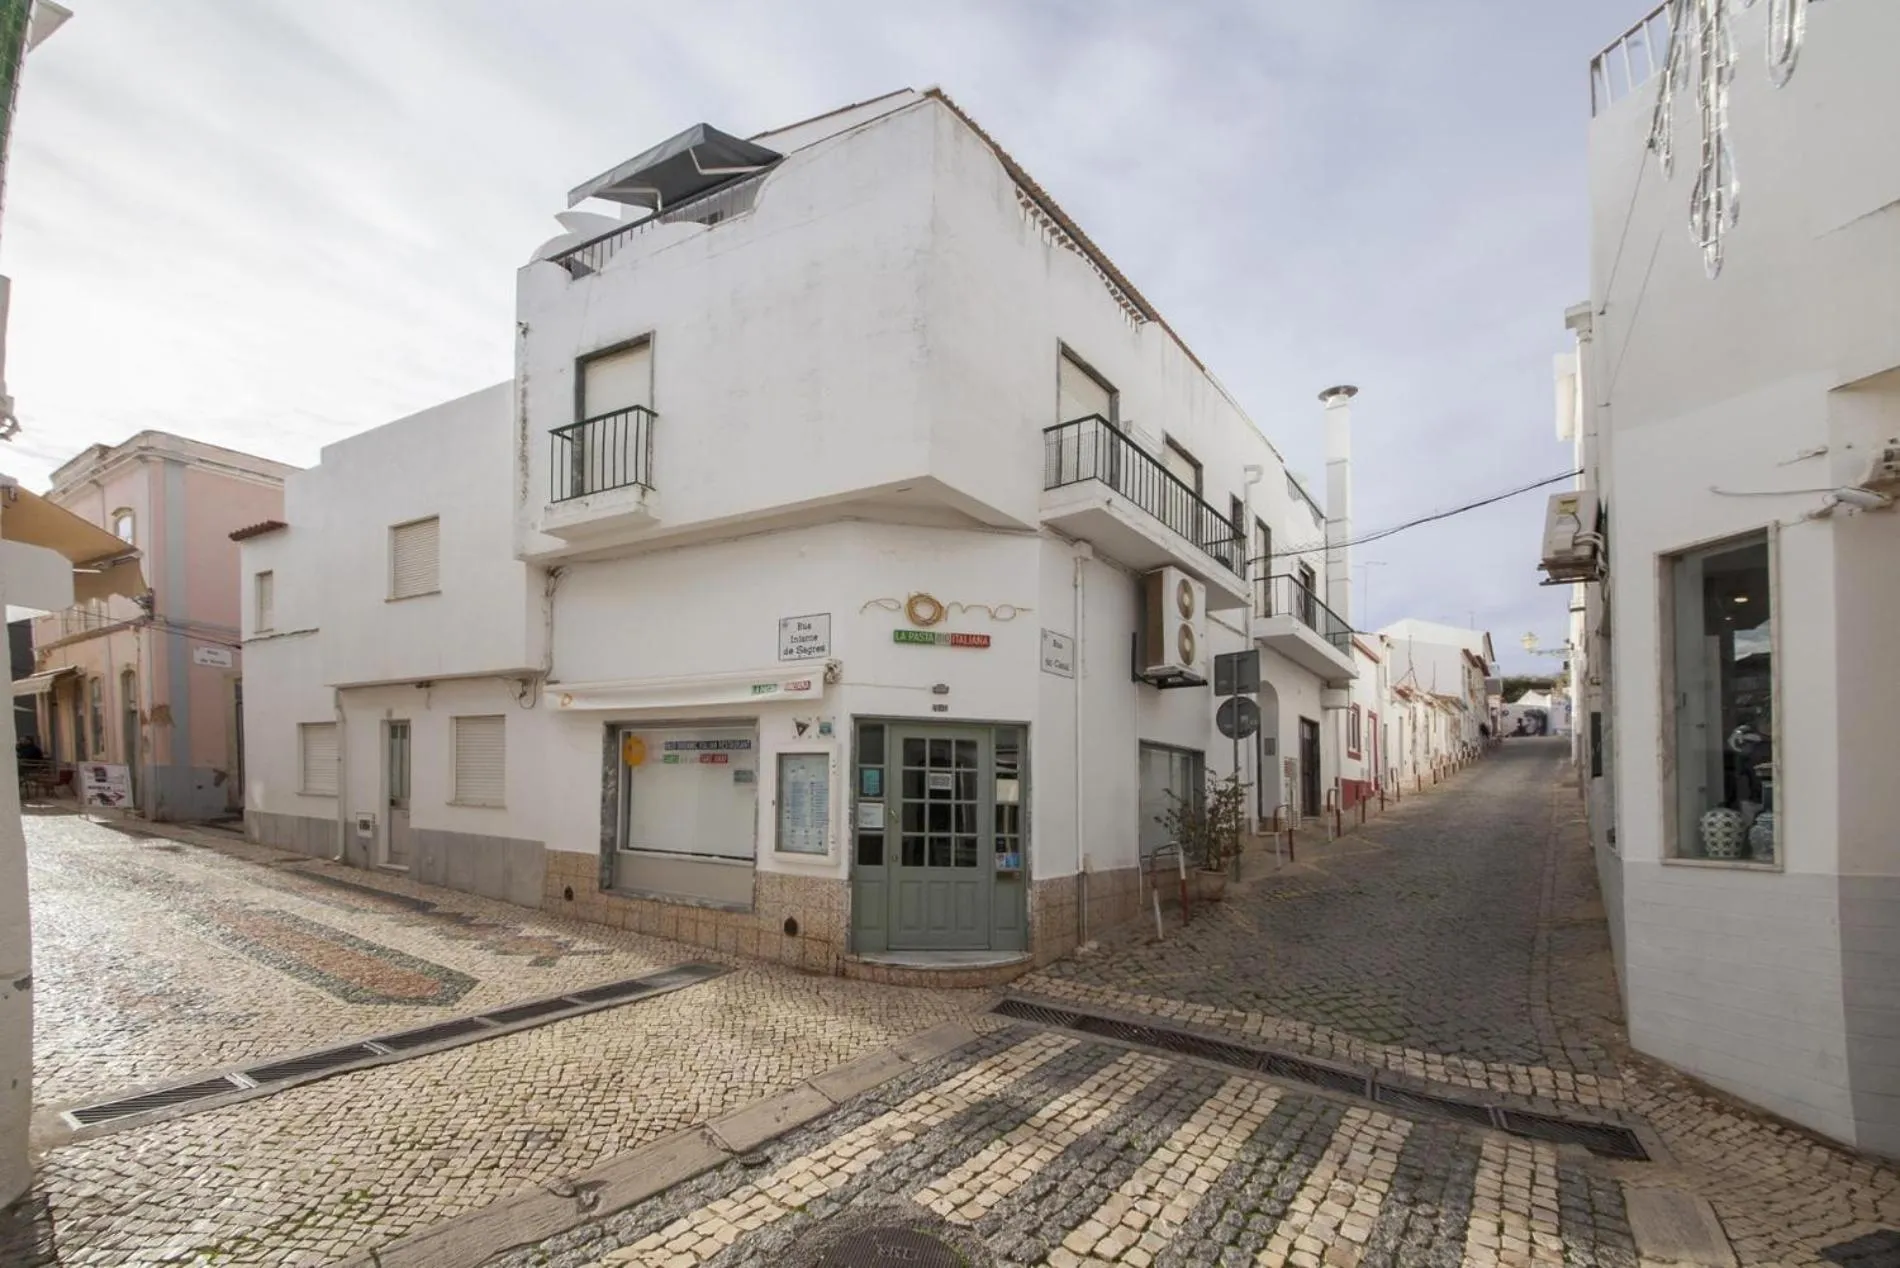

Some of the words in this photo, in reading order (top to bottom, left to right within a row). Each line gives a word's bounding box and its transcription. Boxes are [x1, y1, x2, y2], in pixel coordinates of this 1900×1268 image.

[797, 621, 812, 632] Rua
[895, 630, 907, 641] LA
[908, 631, 935, 643] PASTA
[951, 633, 990, 646] ITALIANA
